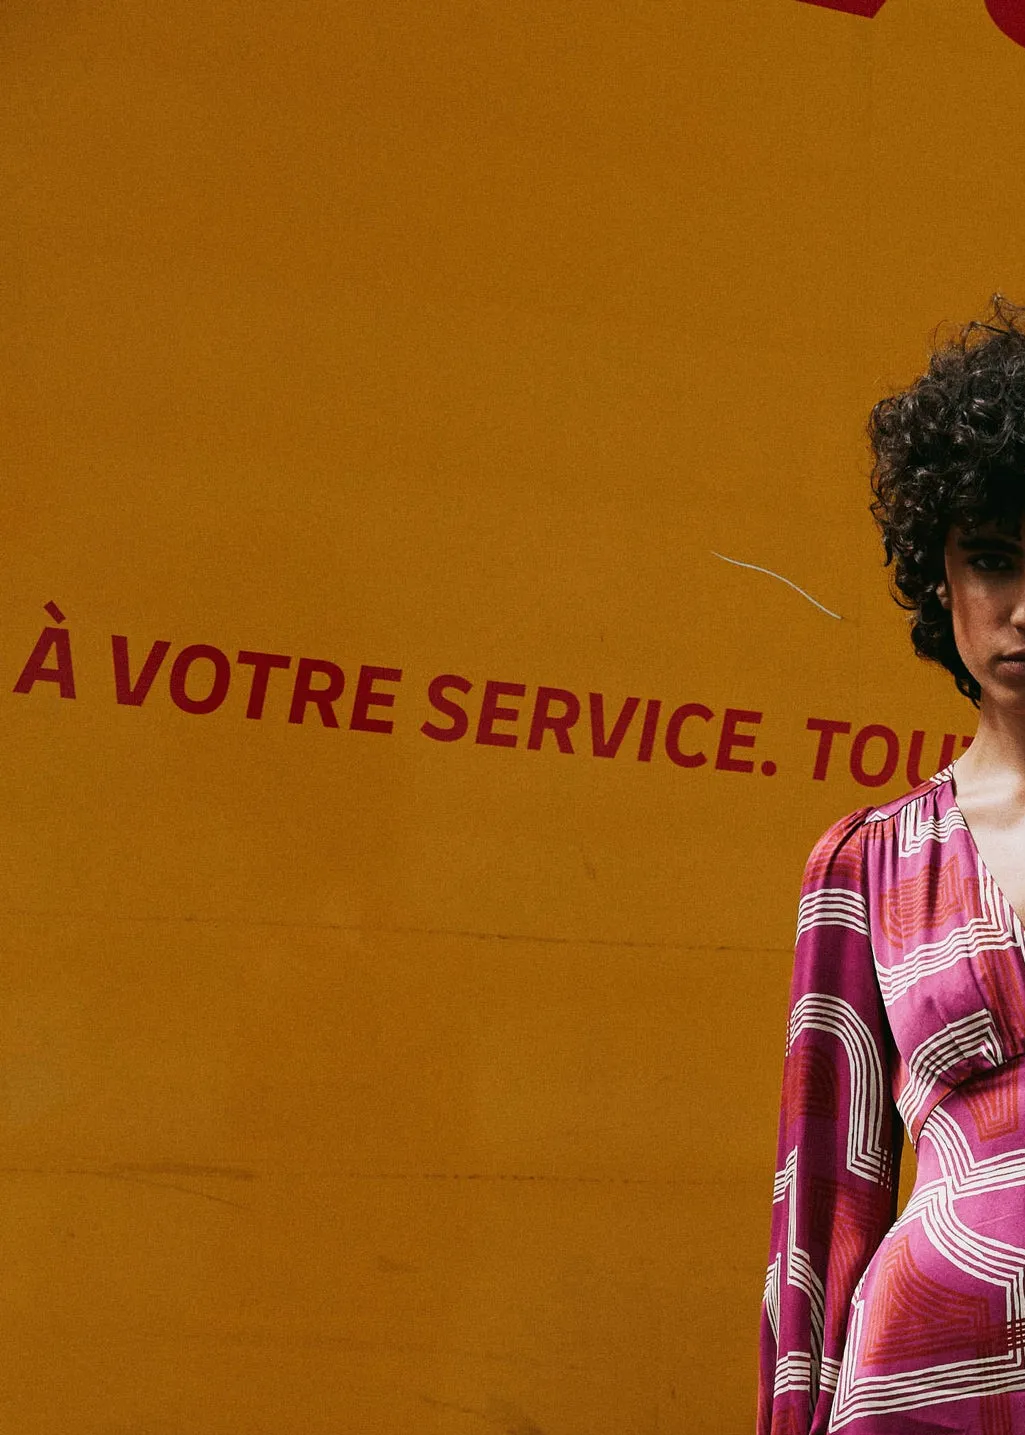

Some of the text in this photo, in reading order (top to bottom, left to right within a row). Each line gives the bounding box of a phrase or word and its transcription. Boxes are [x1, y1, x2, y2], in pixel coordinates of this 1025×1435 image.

[12, 599, 78, 700] À
[111, 634, 403, 735] VOTRE
[419, 673, 777, 777] SERVICE.
[806, 717, 975, 789] TOU
